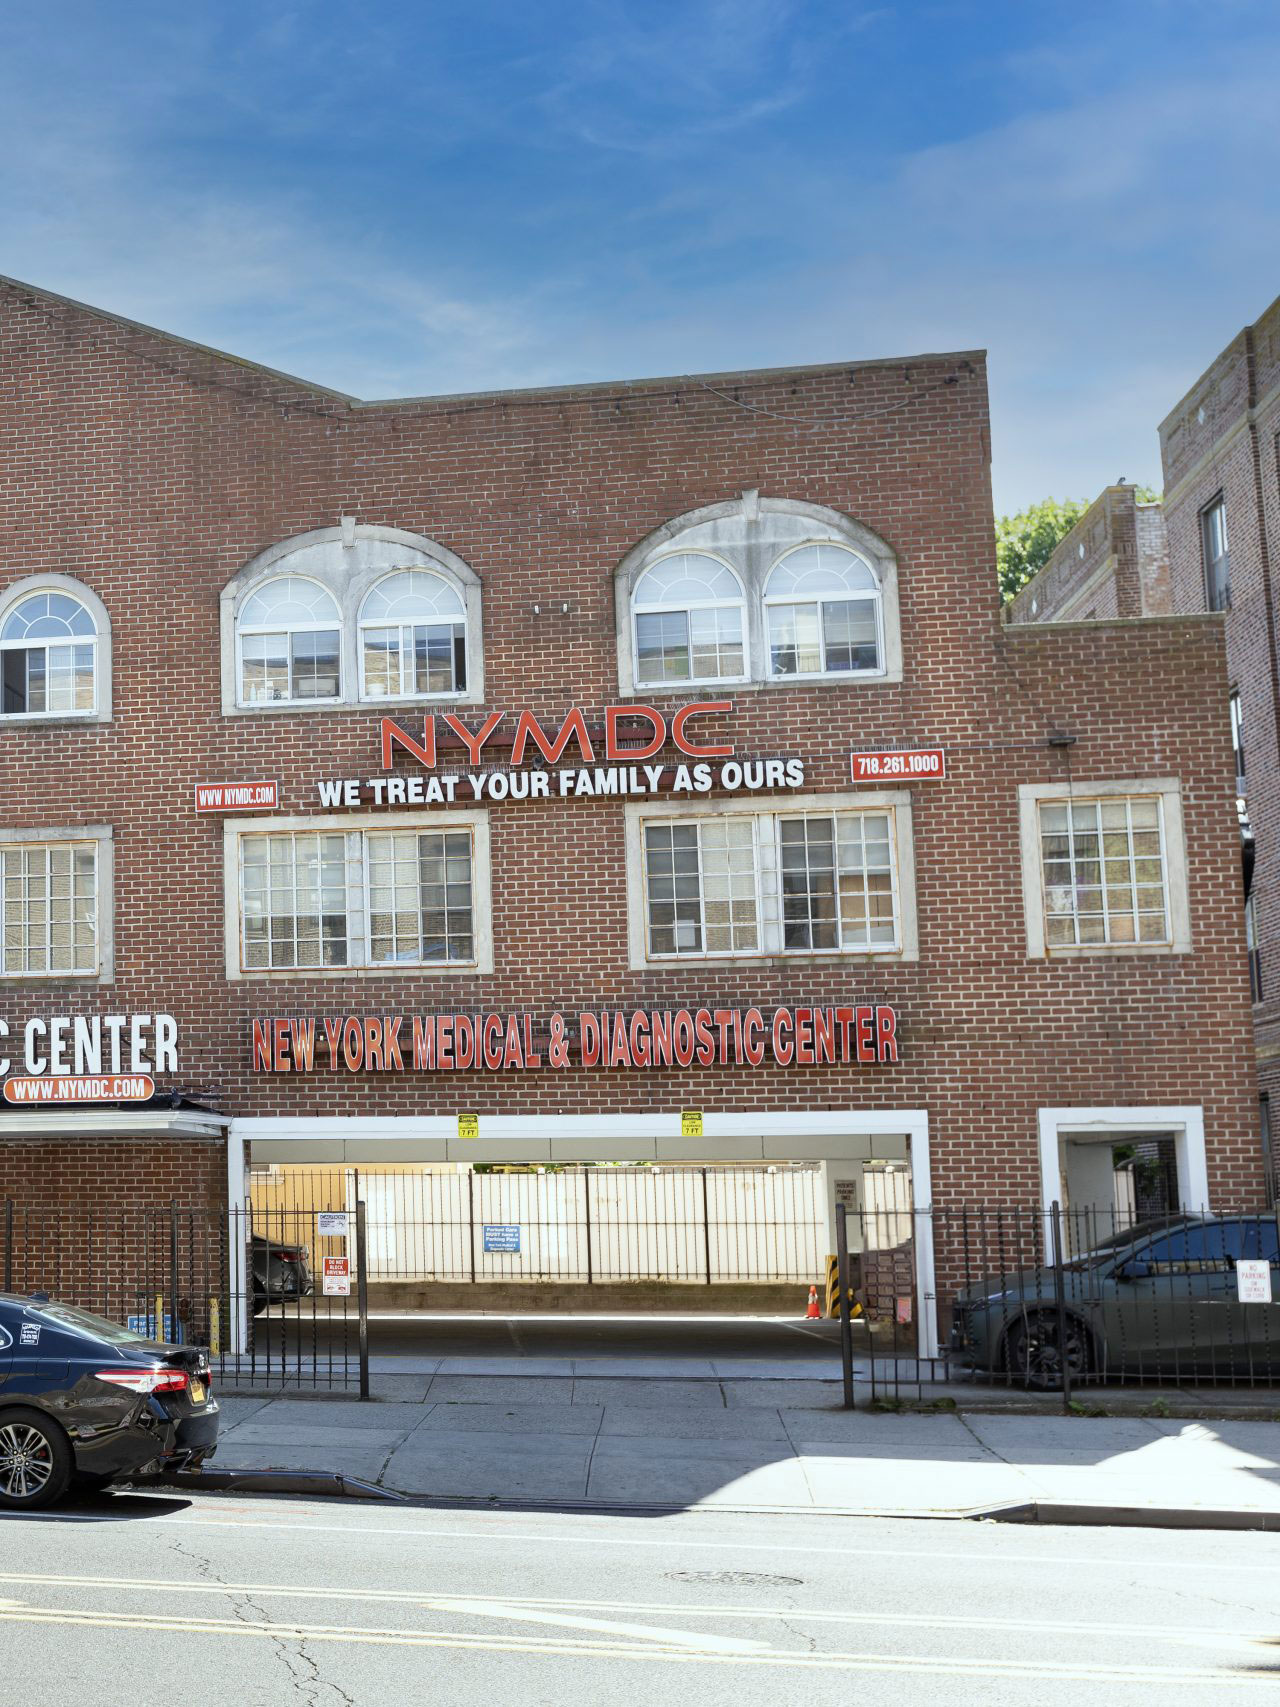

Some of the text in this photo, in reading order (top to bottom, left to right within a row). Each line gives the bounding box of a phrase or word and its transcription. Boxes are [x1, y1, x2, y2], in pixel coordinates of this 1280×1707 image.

[381, 701, 735, 770] NYMDC
[318, 759, 805, 807] WE TREAT YOUR FAMILY AS OURS
[858, 755, 939, 774] 718.261.1000
[199, 787, 274, 806] WWW NYMDC.COM
[25, 1014, 178, 1075] CENTER
[252, 1006, 898, 1072] NEW YORK MEDICAL & DIAGNOSTIC CENTER
[13, 1079, 145, 1100] WWW.NYMDC.COM
